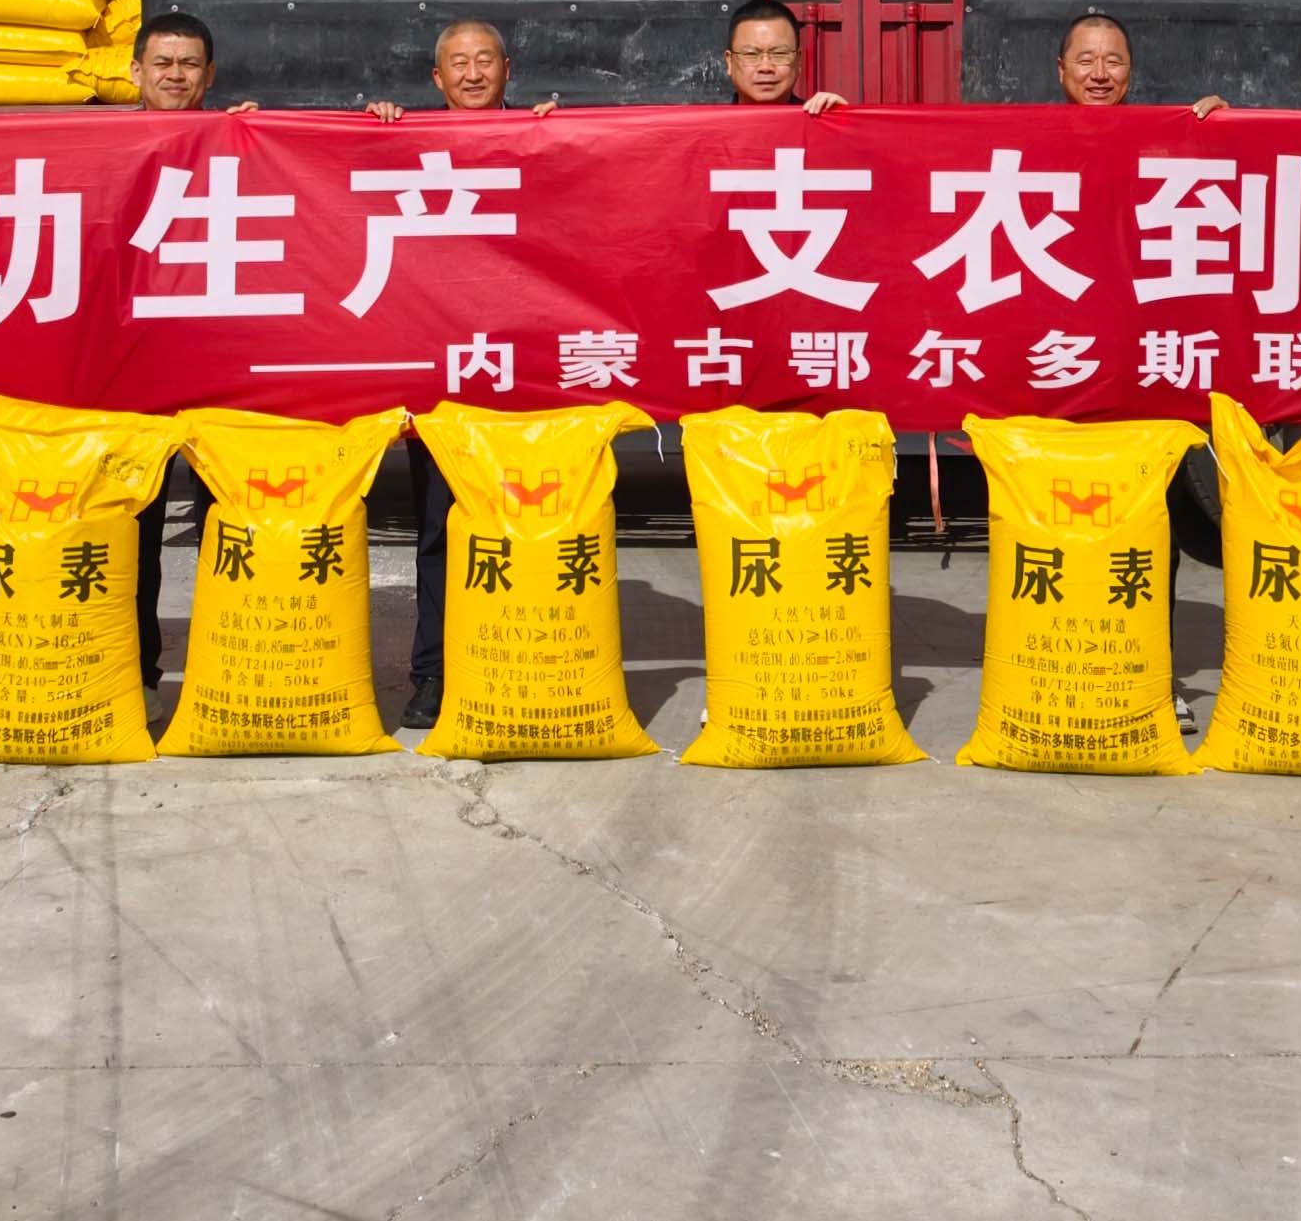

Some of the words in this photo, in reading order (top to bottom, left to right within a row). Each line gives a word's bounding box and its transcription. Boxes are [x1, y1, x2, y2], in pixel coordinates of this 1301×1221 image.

[213, 520, 344, 585] 尿素
[465, 533, 602, 596] 尿素
[729, 532, 872, 598] 尿素
[1011, 541, 1154, 609] 尿素
[242, 594, 319, 612] 天然气制造
[3, 612, 80, 629] 天然气制造
[500, 605, 576, 622] 天然气制造
[772, 605, 846, 623] 天然气制造
[1051, 617, 1127, 635] 天然气制造
